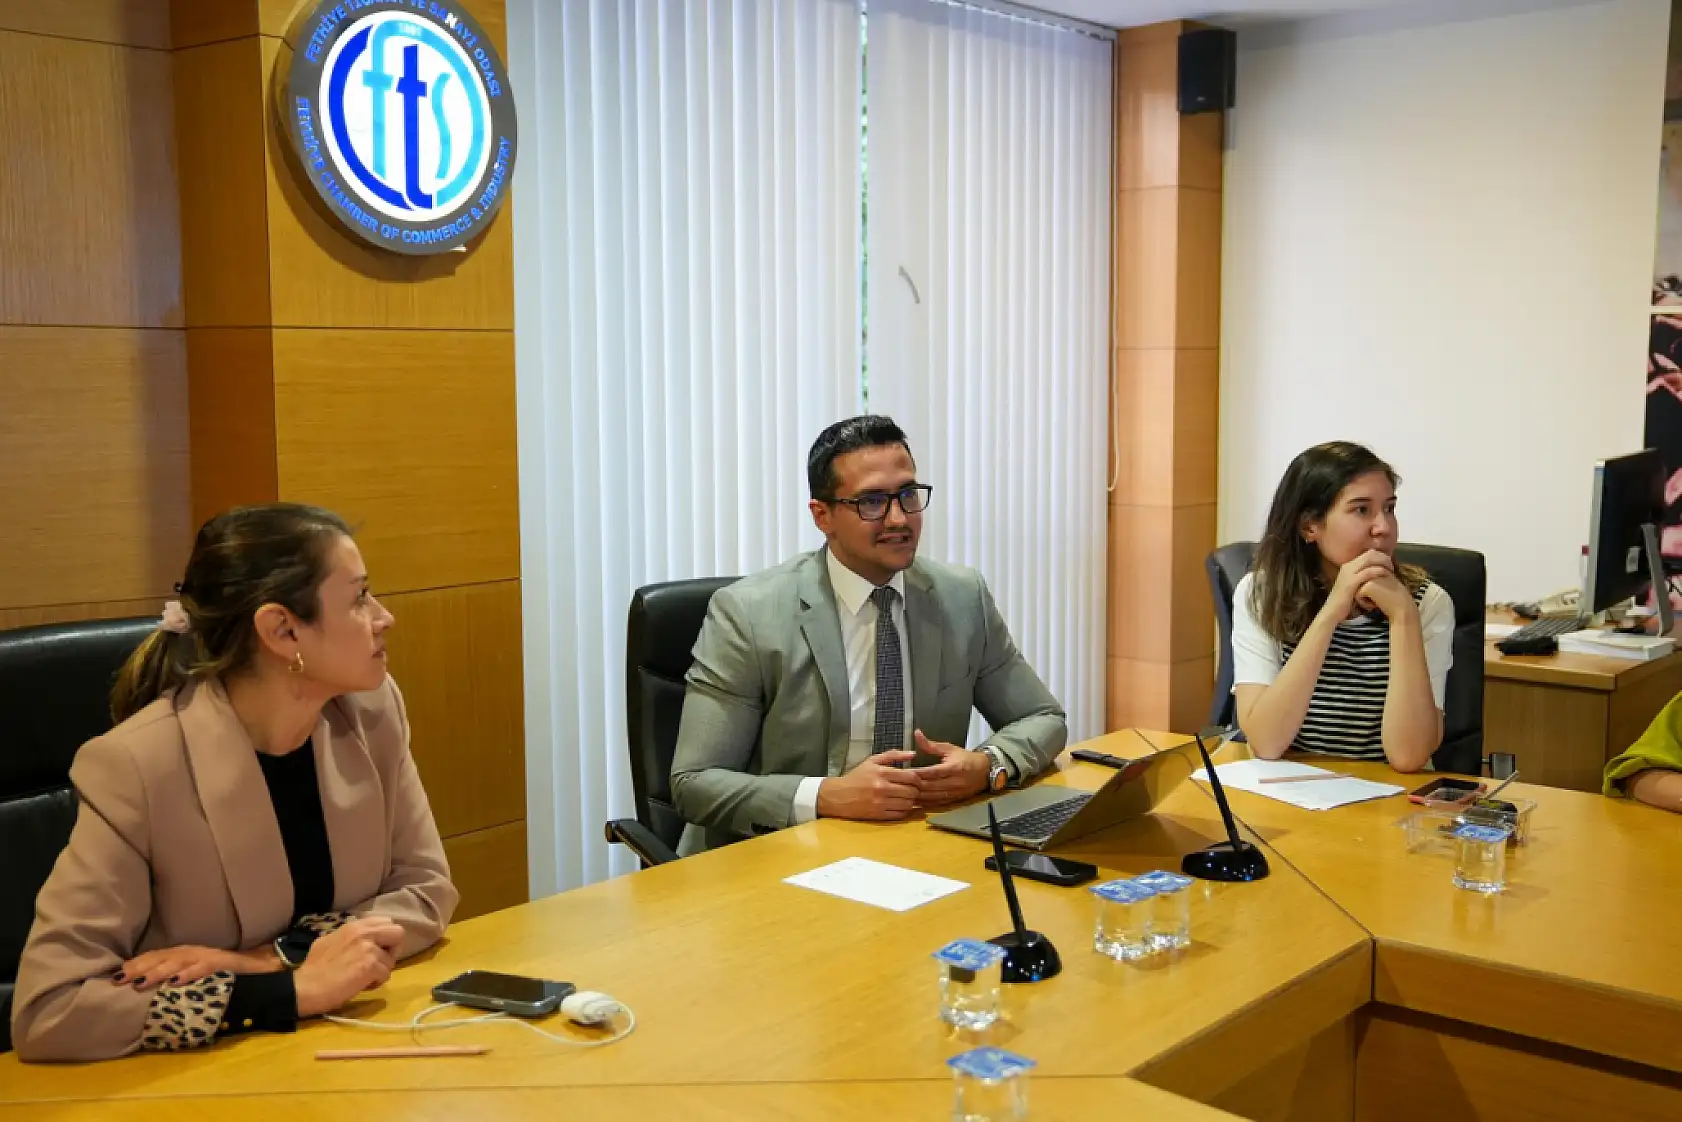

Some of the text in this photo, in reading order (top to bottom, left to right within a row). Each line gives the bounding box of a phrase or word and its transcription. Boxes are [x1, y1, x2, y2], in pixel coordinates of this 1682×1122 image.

[381, 223, 400, 239] OF
[402, 213, 473, 244] COMMERCE
[470, 207, 484, 220] &
[479, 136, 510, 210] INDUSTRY
